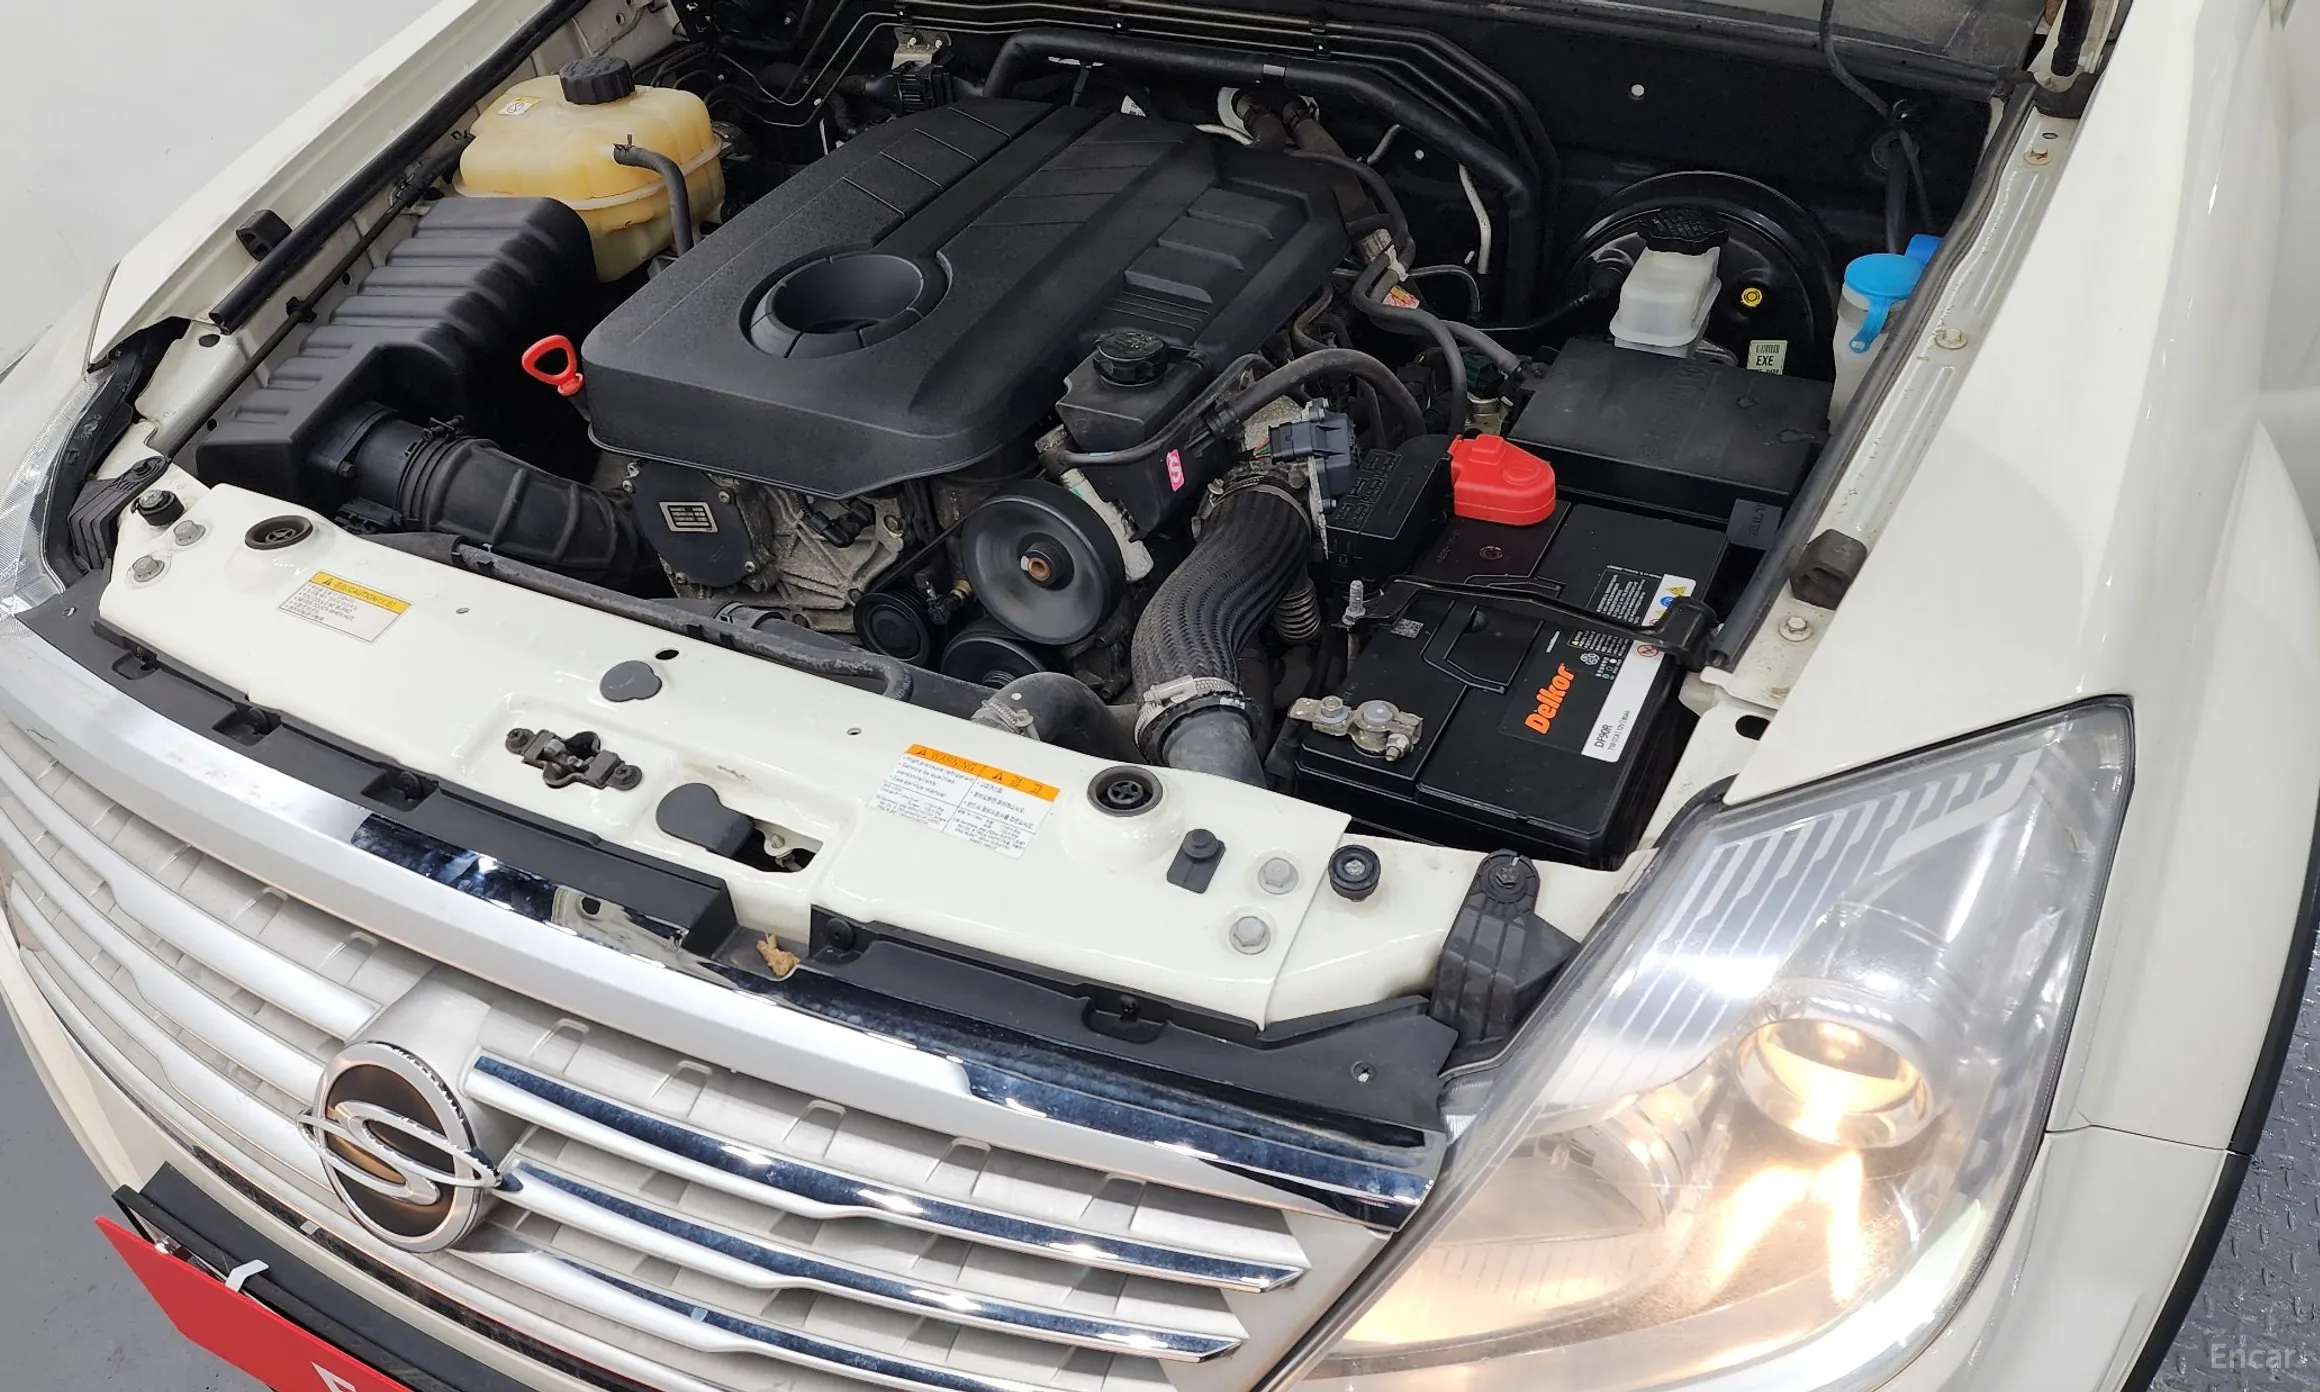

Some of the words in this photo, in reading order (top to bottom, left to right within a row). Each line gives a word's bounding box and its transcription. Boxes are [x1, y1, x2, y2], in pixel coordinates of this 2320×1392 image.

[1756, 355, 1774, 367] EXE
[1524, 663, 1575, 734] Delkor
[931, 751, 976, 772] WARNING
